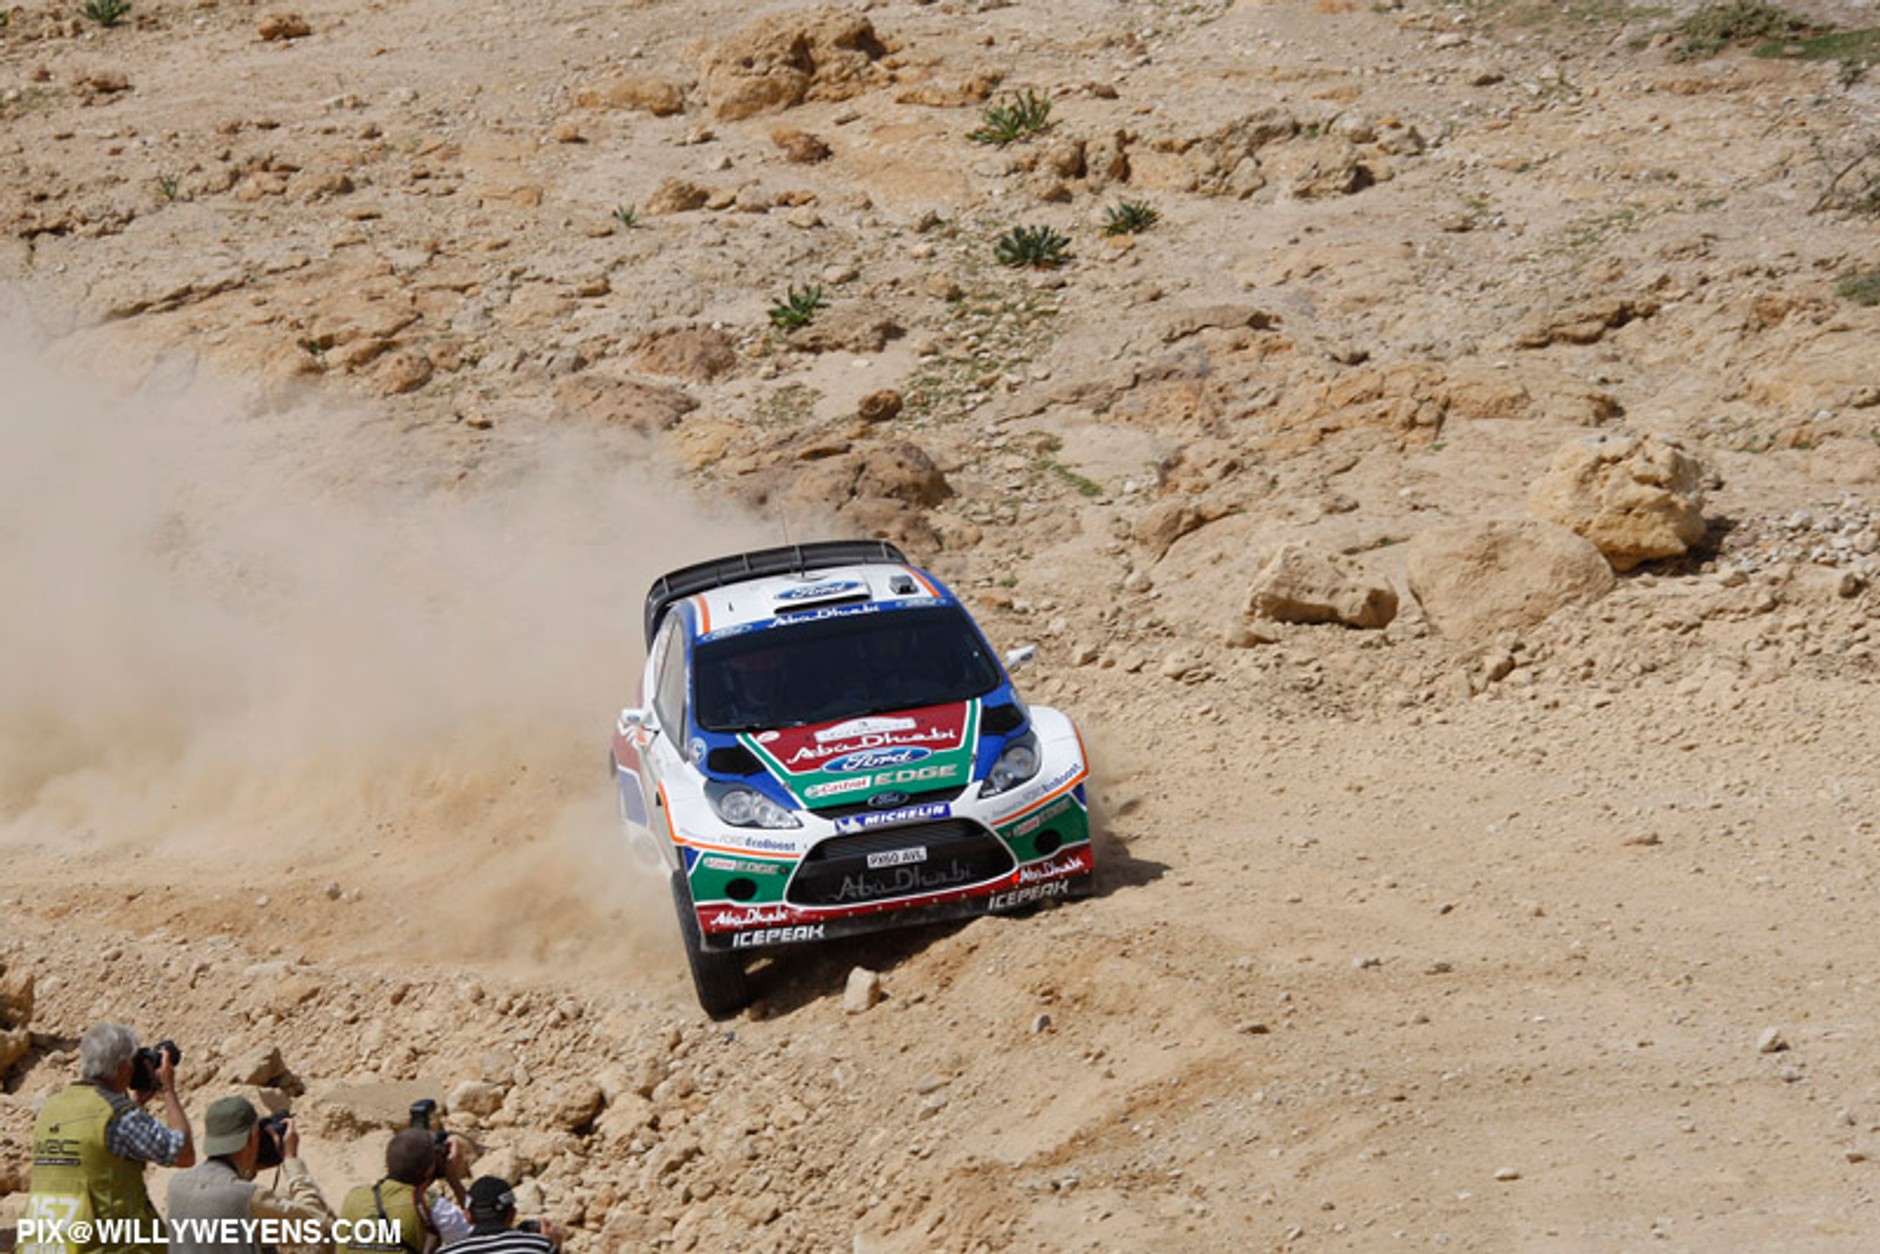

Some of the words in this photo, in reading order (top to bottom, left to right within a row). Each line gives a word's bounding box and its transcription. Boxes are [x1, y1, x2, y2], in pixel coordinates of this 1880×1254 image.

[787, 743, 854, 764] Abu
[859, 727, 956, 748] Dhabi
[841, 750, 914, 771] Ford
[816, 776, 868, 795] Castrol
[874, 764, 958, 786] EDGE
[864, 805, 946, 826] MICHELIN
[829, 873, 887, 901] Abu
[895, 859, 973, 892] Dhabi
[987, 878, 1070, 910] ICEPEAK
[710, 911, 743, 927] Abu
[745, 905, 789, 924] Dhabi
[733, 924, 826, 948] ICEPEAK
